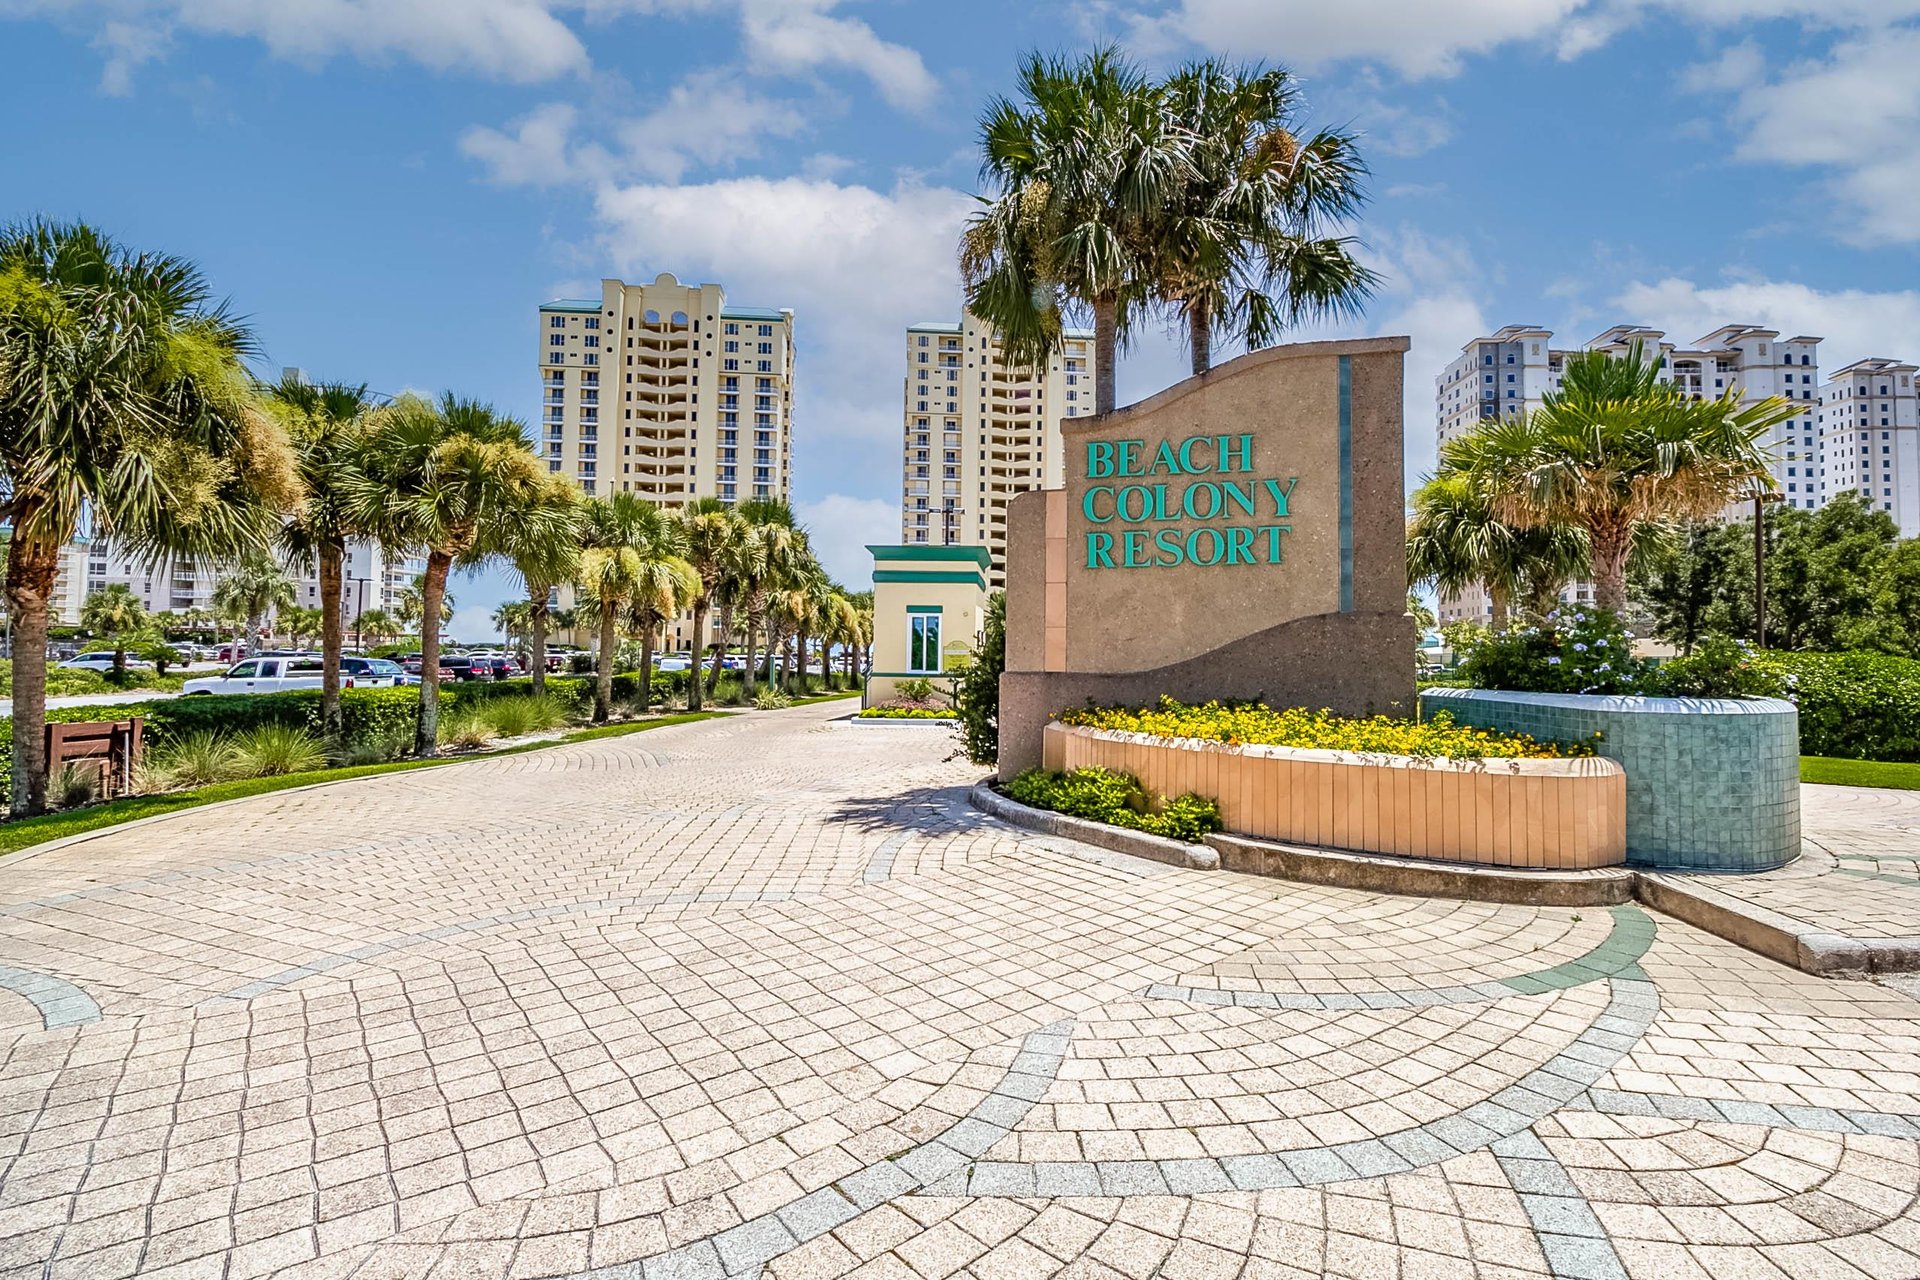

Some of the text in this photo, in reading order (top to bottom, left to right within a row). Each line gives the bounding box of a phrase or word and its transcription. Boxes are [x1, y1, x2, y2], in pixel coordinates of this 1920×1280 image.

[1086, 433, 1254, 478] BEACH
[1082, 478, 1298, 523] COLONY
[1086, 525, 1292, 568] RESORT
